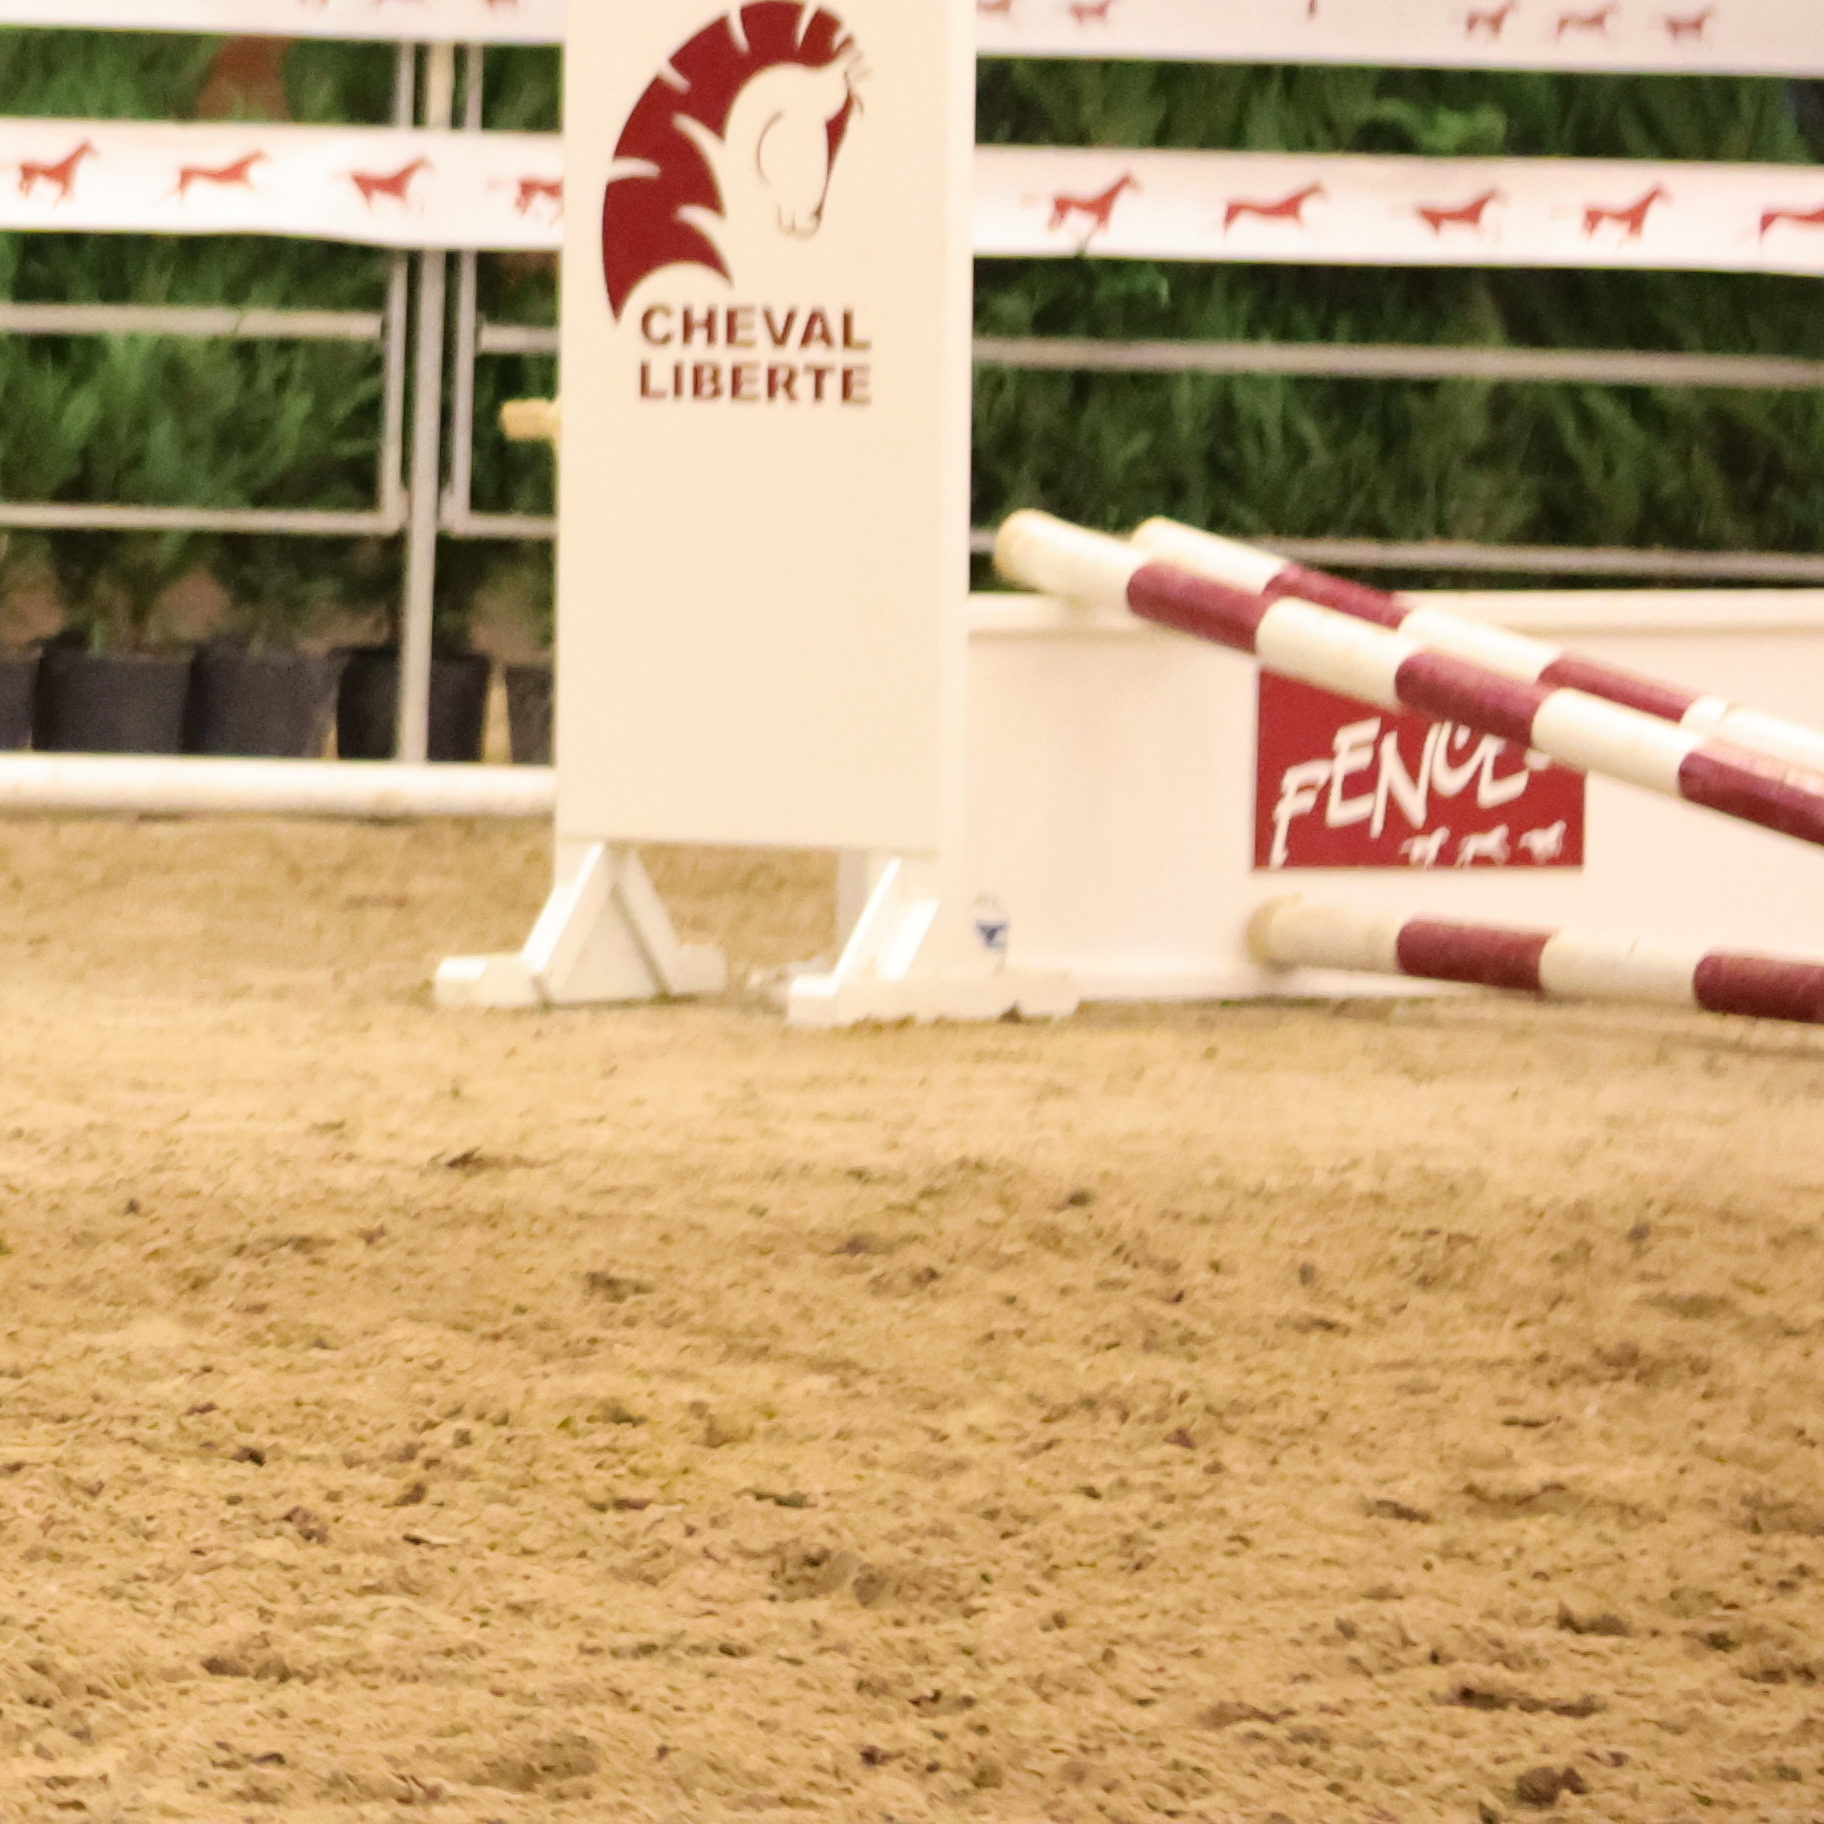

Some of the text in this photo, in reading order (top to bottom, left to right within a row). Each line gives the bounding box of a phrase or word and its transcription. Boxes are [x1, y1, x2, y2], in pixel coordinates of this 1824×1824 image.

[641, 303, 871, 349] CHEVAL
[640, 359, 871, 405] LIBERTE
[1270, 717, 1552, 868] FENCE
